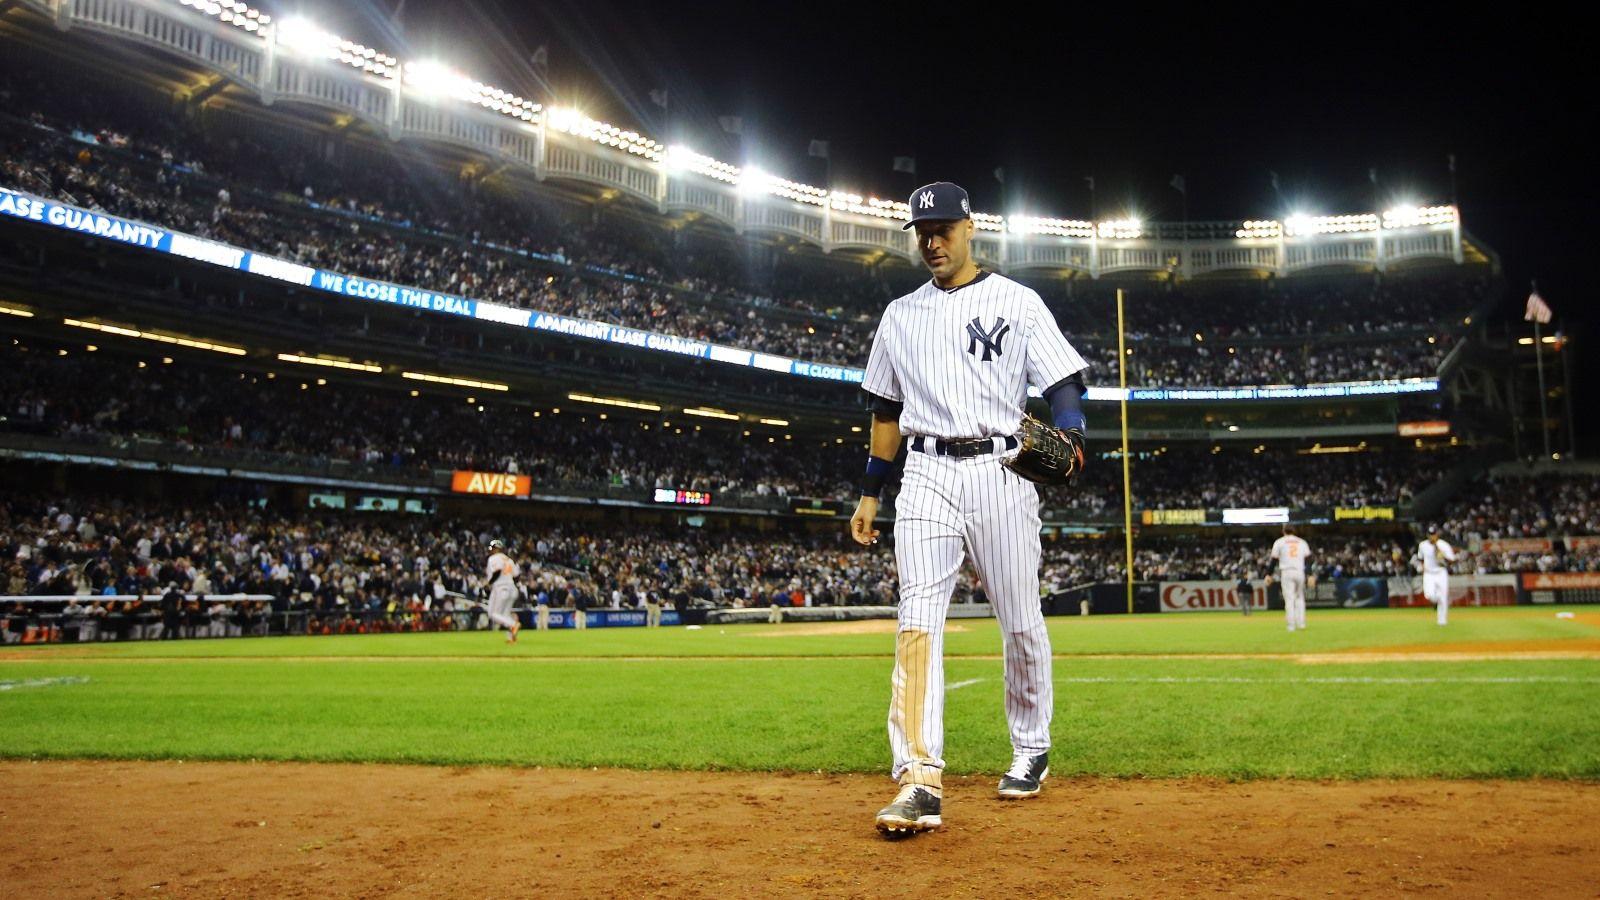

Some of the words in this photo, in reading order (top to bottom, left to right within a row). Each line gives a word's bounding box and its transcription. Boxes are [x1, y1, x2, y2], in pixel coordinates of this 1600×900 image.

[919, 190, 935, 209] NY
[0, 194, 45, 220] ASE
[48, 206, 164, 249] GUARANTY
[320, 273, 343, 293] WE
[345, 280, 398, 303] CLOSE
[401, 289, 430, 309] THE
[433, 296, 471, 316] DEAL
[534, 314, 610, 340] APARTMENT
[611, 327, 646, 346] LEASE
[647, 335, 708, 357] GUARANTY
[966, 316, 1010, 361] NY
[467, 472, 517, 496] AVIS
